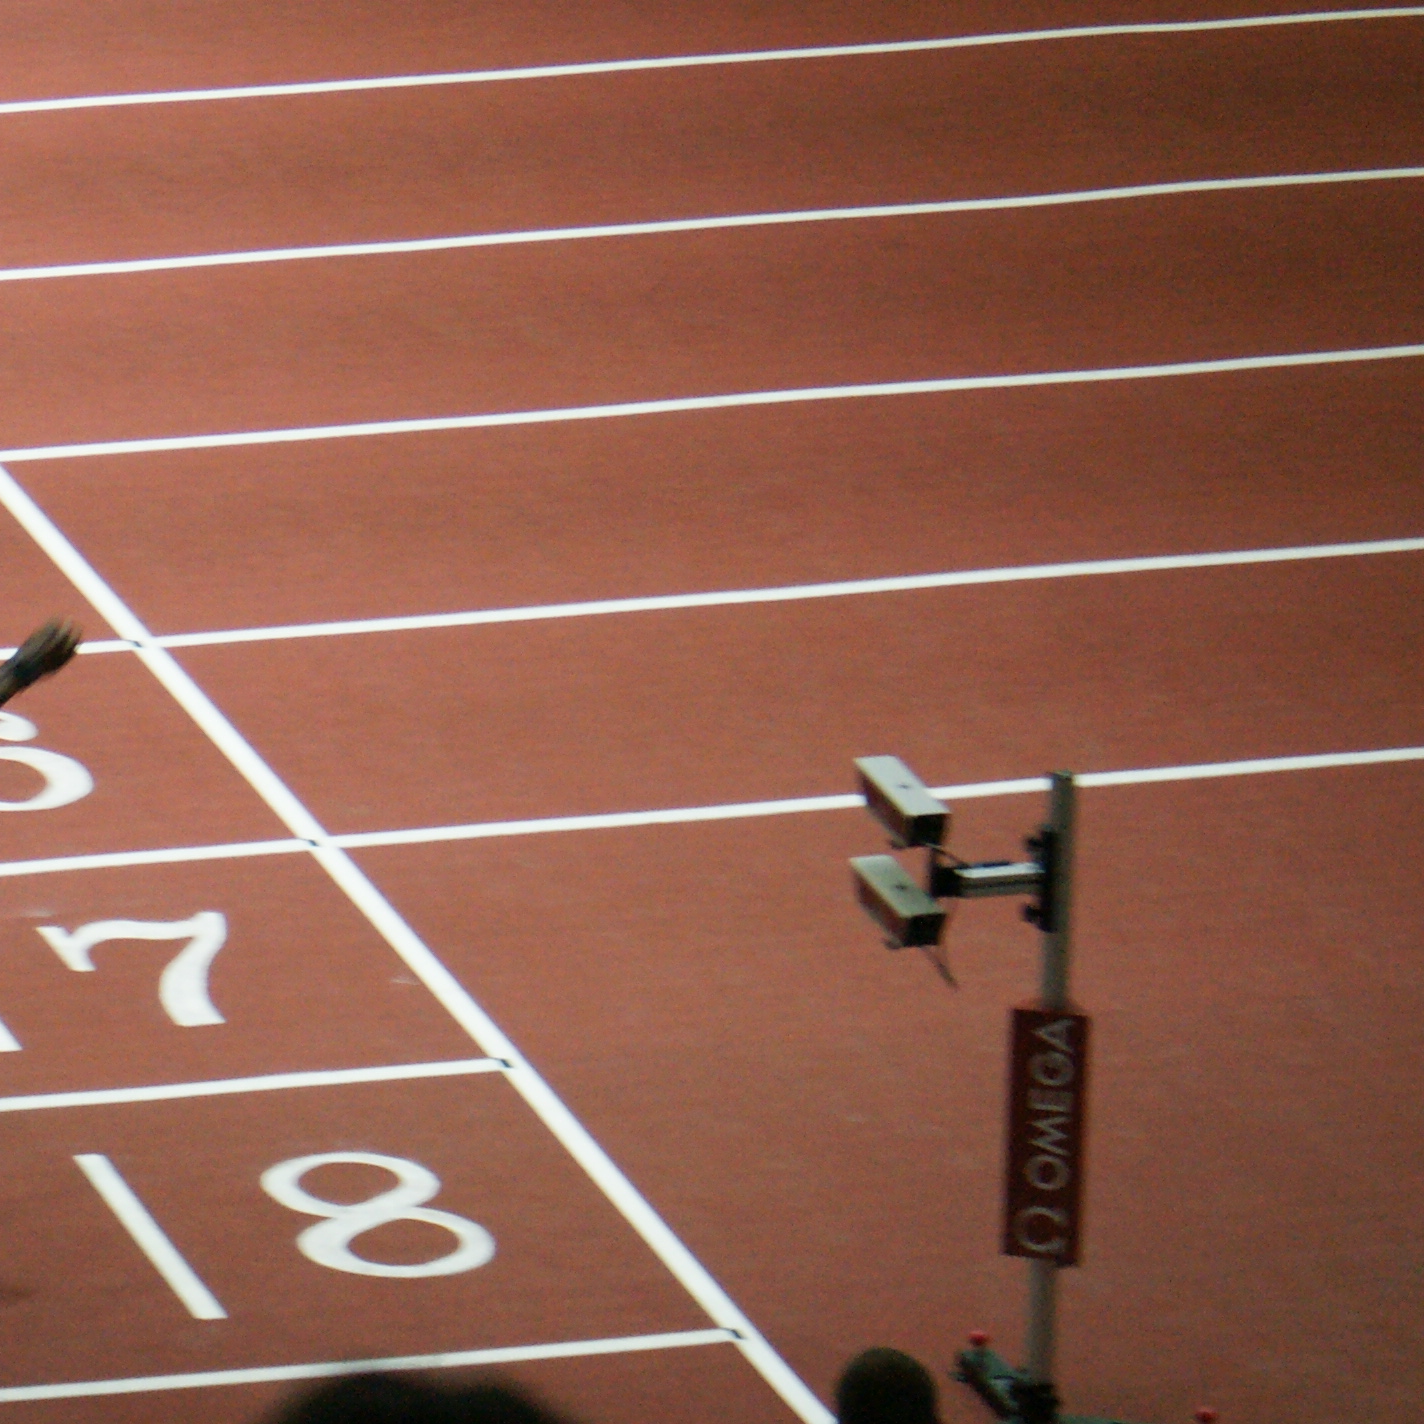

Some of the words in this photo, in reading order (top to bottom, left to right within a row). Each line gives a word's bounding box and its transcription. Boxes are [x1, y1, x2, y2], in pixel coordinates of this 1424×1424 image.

[35, 911, 227, 1028] 7
[1024, 1018, 1077, 1192] OMEGA
[260, 1151, 496, 1278] 8
